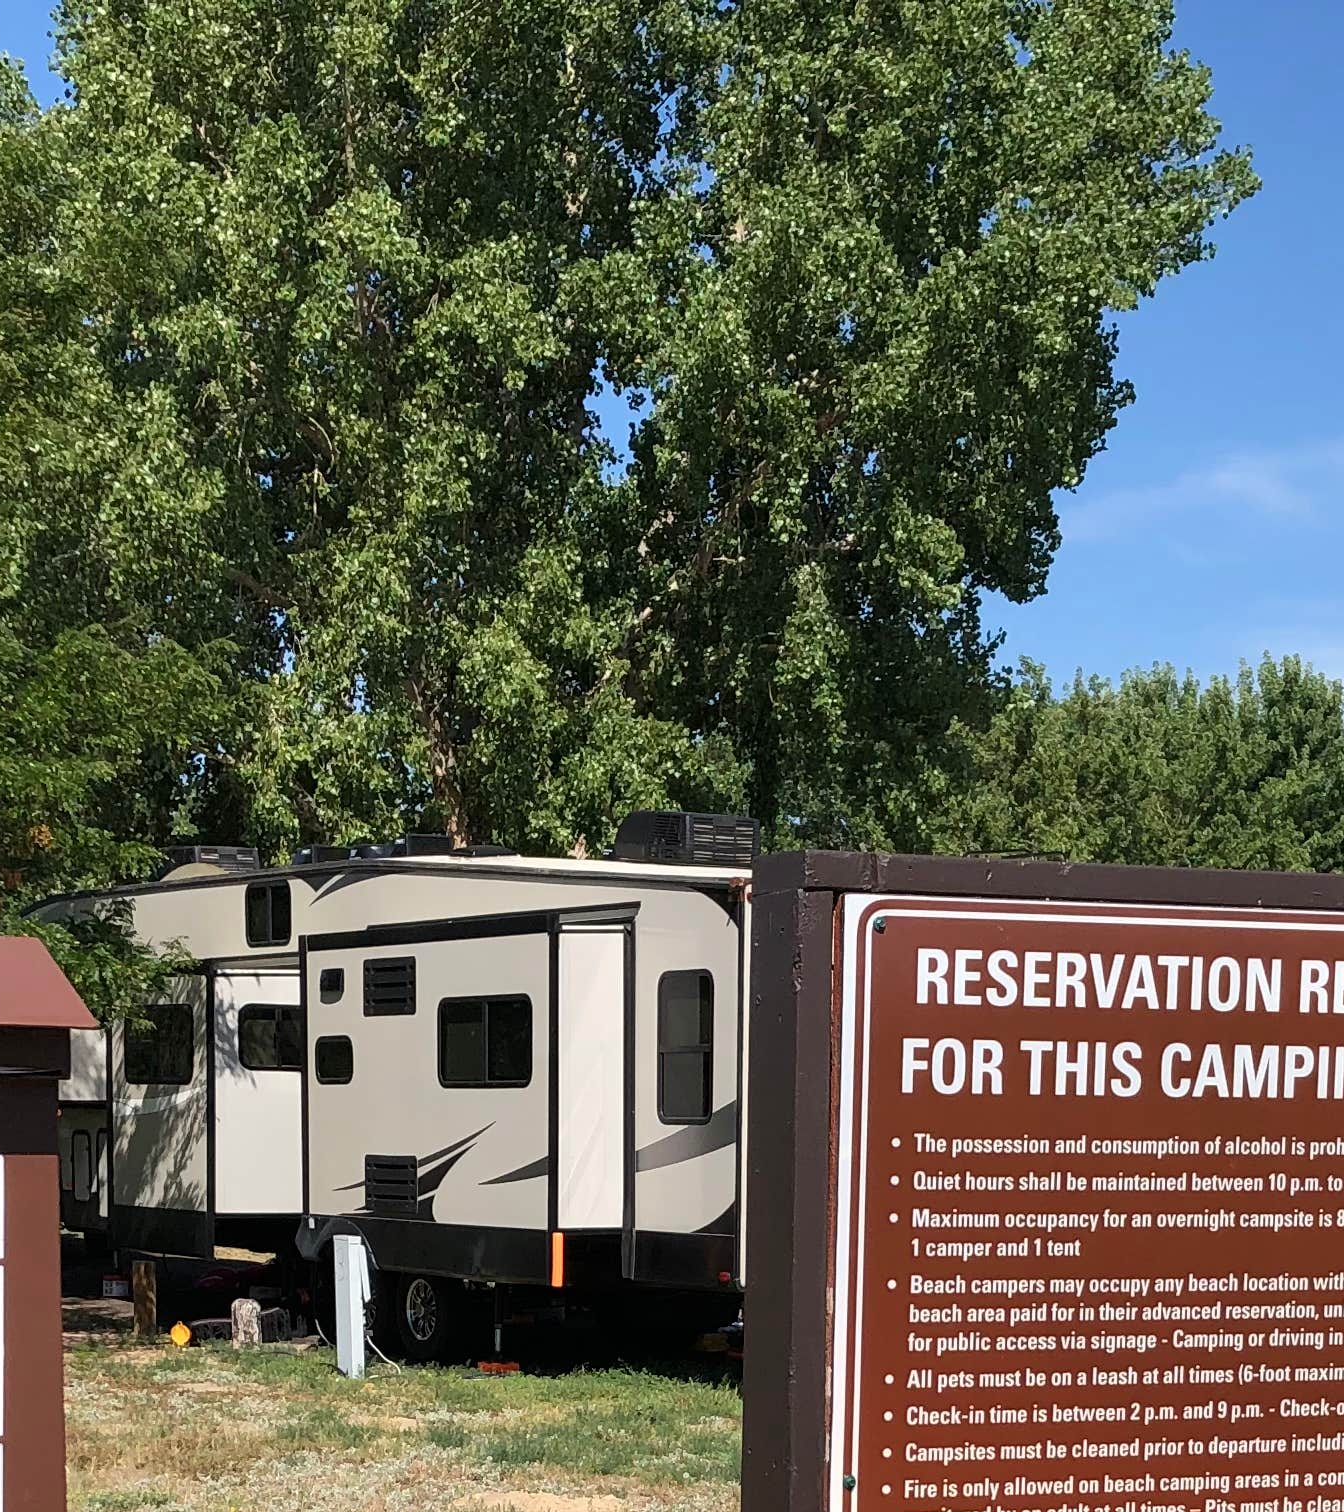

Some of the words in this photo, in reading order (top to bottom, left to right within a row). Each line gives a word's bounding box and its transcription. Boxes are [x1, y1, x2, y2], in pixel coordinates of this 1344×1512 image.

[915, 947, 1282, 1012] RESERVATION
[901, 1037, 1003, 1094] FOR
[1019, 1039, 1142, 1097] THIS
[913, 1132, 947, 1152] The
[951, 1133, 1049, 1158] possession
[1054, 1134, 1086, 1154] and
[1090, 1135, 1199, 1159] consumption
[1204, 1135, 1221, 1154] of
[1224, 1135, 1286, 1155] alcohol
[1290, 1136, 1305, 1155] is
[912, 1170, 961, 1190] Quiet
[964, 1170, 1014, 1190] hours
[1018, 1171, 1061, 1191] shall
[1066, 1171, 1087, 1191] be
[1091, 1171, 1186, 1191] maintained
[1191, 1171, 1263, 1191] between
[1268, 1172, 1286, 1191] 10
[1289, 1177, 1323, 1196] p.m.
[1326, 1174, 1343, 1191] to
[911, 1208, 999, 1228] Maximum
[1004, 1213, 1099, 1232] occupancy
[1102, 1208, 1127, 1227] for
[1131, 1213, 1152, 1227] an
[1156, 1208, 1236, 1231] overnight
[1239, 1208, 1314, 1232] campsite
[1318, 1208, 1332, 1227] is
[906, 1368, 932, 1388] All
[936, 1370, 974, 1393] pets
[978, 1370, 1021, 1387] must
[1025, 1367, 1046, 1386] be
[1050, 1371, 1072, 1386] on
[1076, 1371, 1087, 1385] a
[1092, 1365, 1137, 1385] leash
[1142, 1367, 1159, 1384] at
[1162, 1365, 1184, 1384] all
[1188, 1364, 1234, 1383] times
[1238, 1363, 1291, 1384] (6-foot
[905, 1441, 995, 1466] Campsites
[1000, 1441, 1042, 1459] must
[1045, 1439, 1067, 1458] be
[1071, 1437, 1139, 1457] cleaned
[1143, 1436, 1184, 1461] prior
[1187, 1438, 1203, 1455] to
[1207, 1435, 1286, 1458] departure
